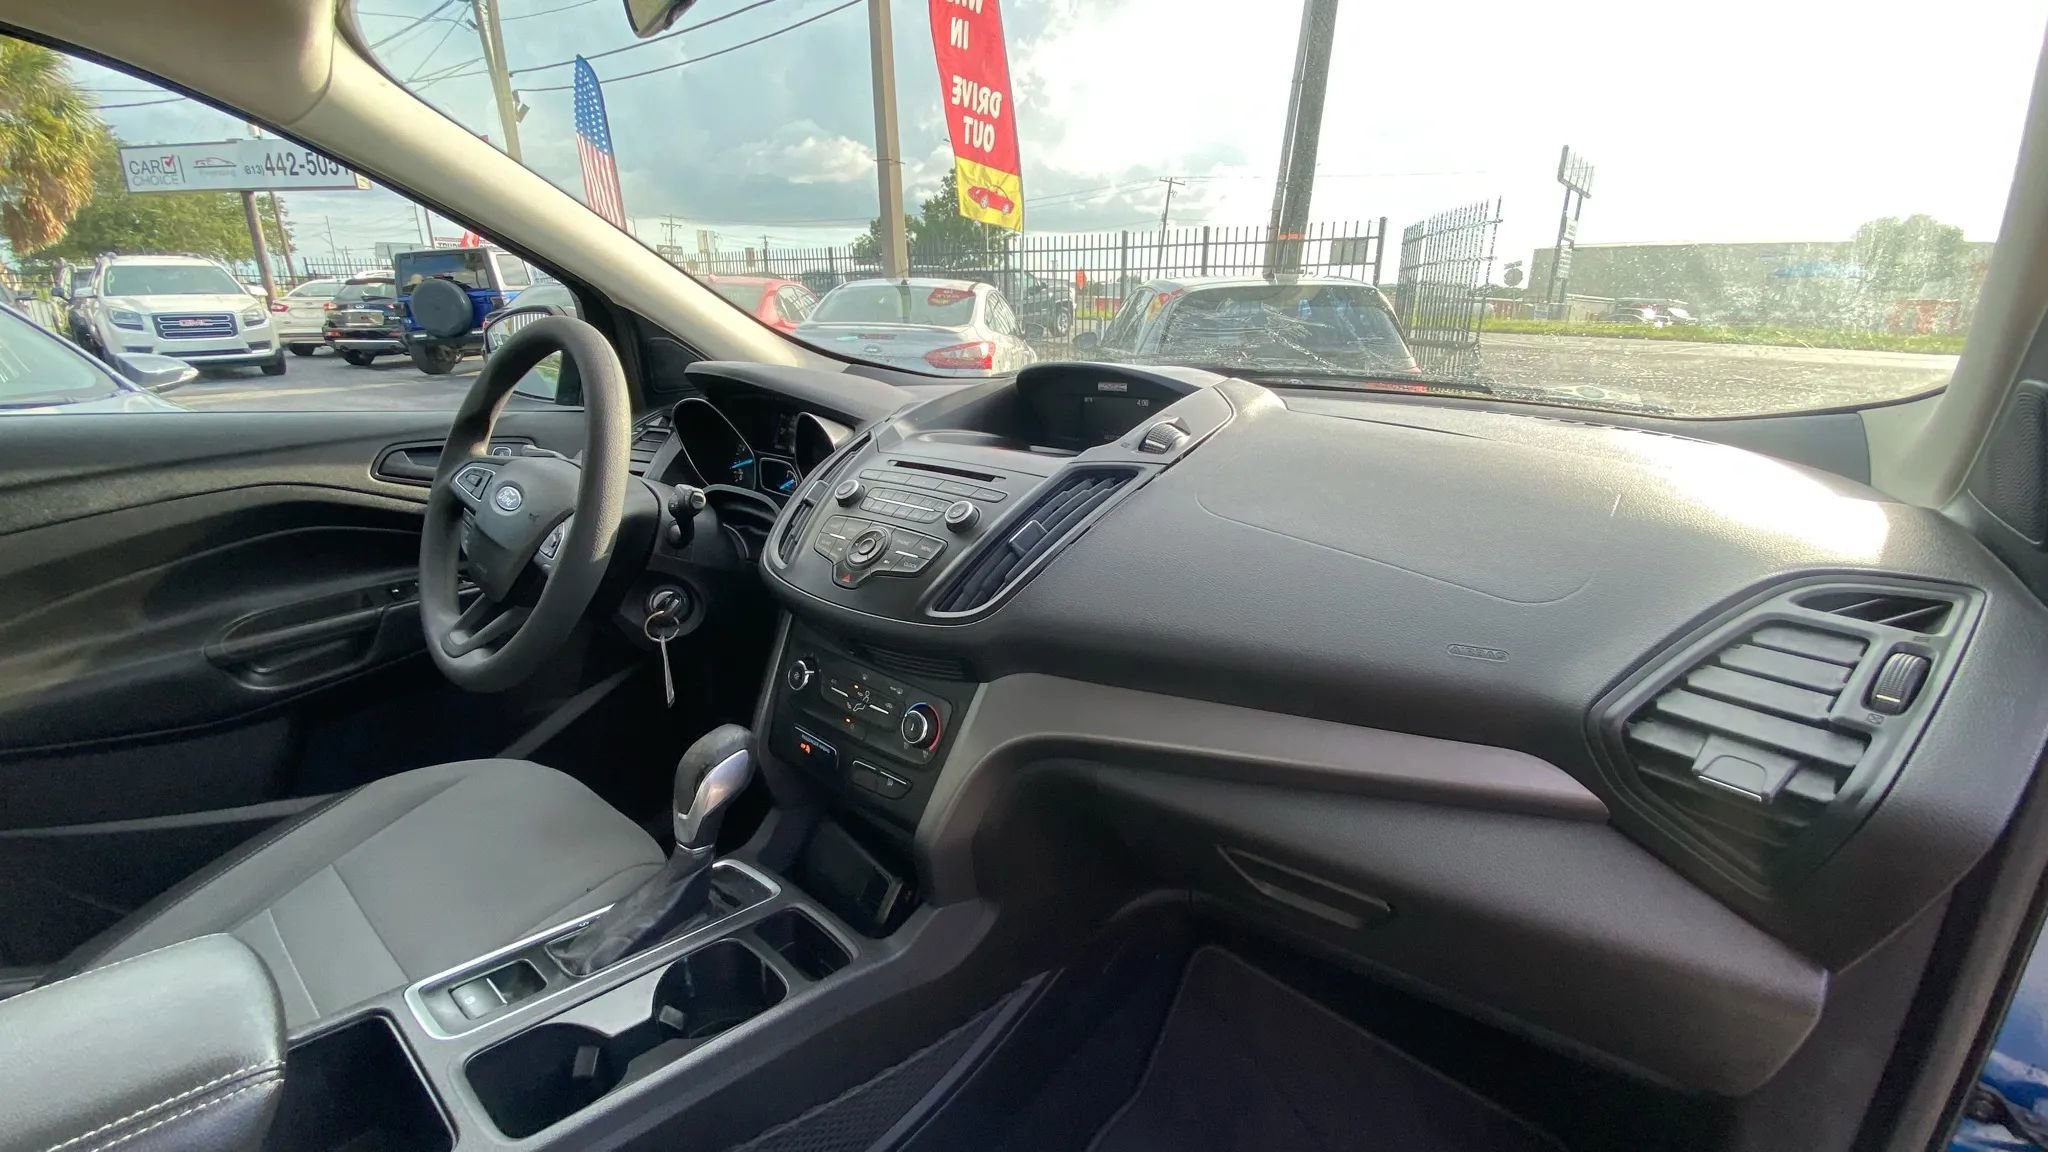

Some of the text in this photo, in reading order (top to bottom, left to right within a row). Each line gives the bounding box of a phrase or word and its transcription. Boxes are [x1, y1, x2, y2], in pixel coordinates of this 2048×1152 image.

[129, 160, 162, 175] CAR
[132, 175, 180, 186] CHOICE
[1449, 646, 1507, 660] AIRBAG
